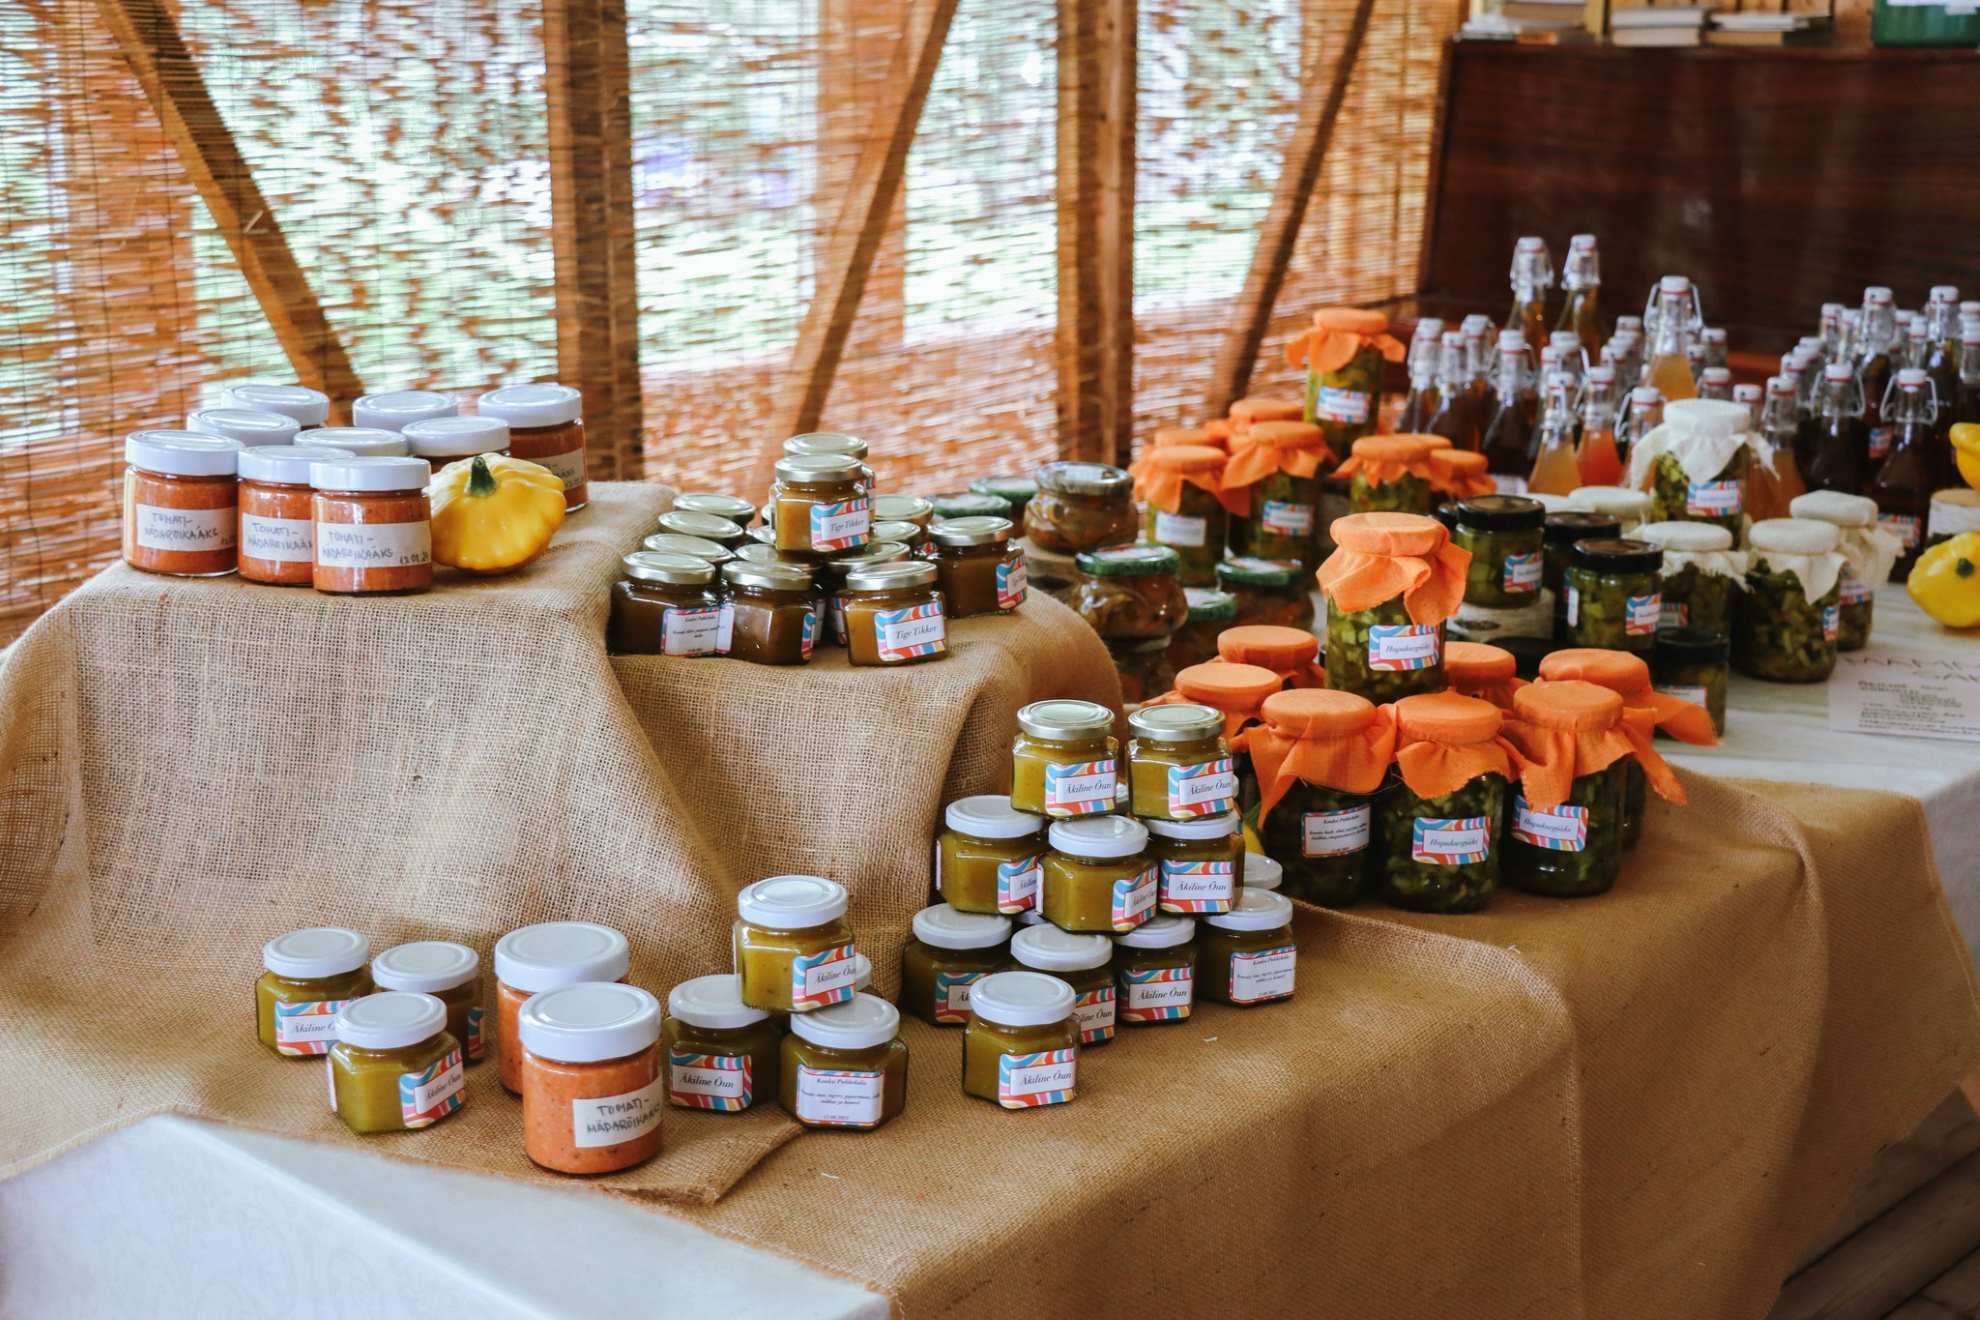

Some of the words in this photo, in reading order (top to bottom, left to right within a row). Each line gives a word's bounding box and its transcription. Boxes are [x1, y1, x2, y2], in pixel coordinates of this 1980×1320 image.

[1168, 987, 1188, 998] Õun
[680, 1071, 713, 1086] Äkiline
[713, 1076, 735, 1089] Õun
[1052, 1069, 1072, 1081] Õun
[596, 1097, 649, 1116] TOMATI-
